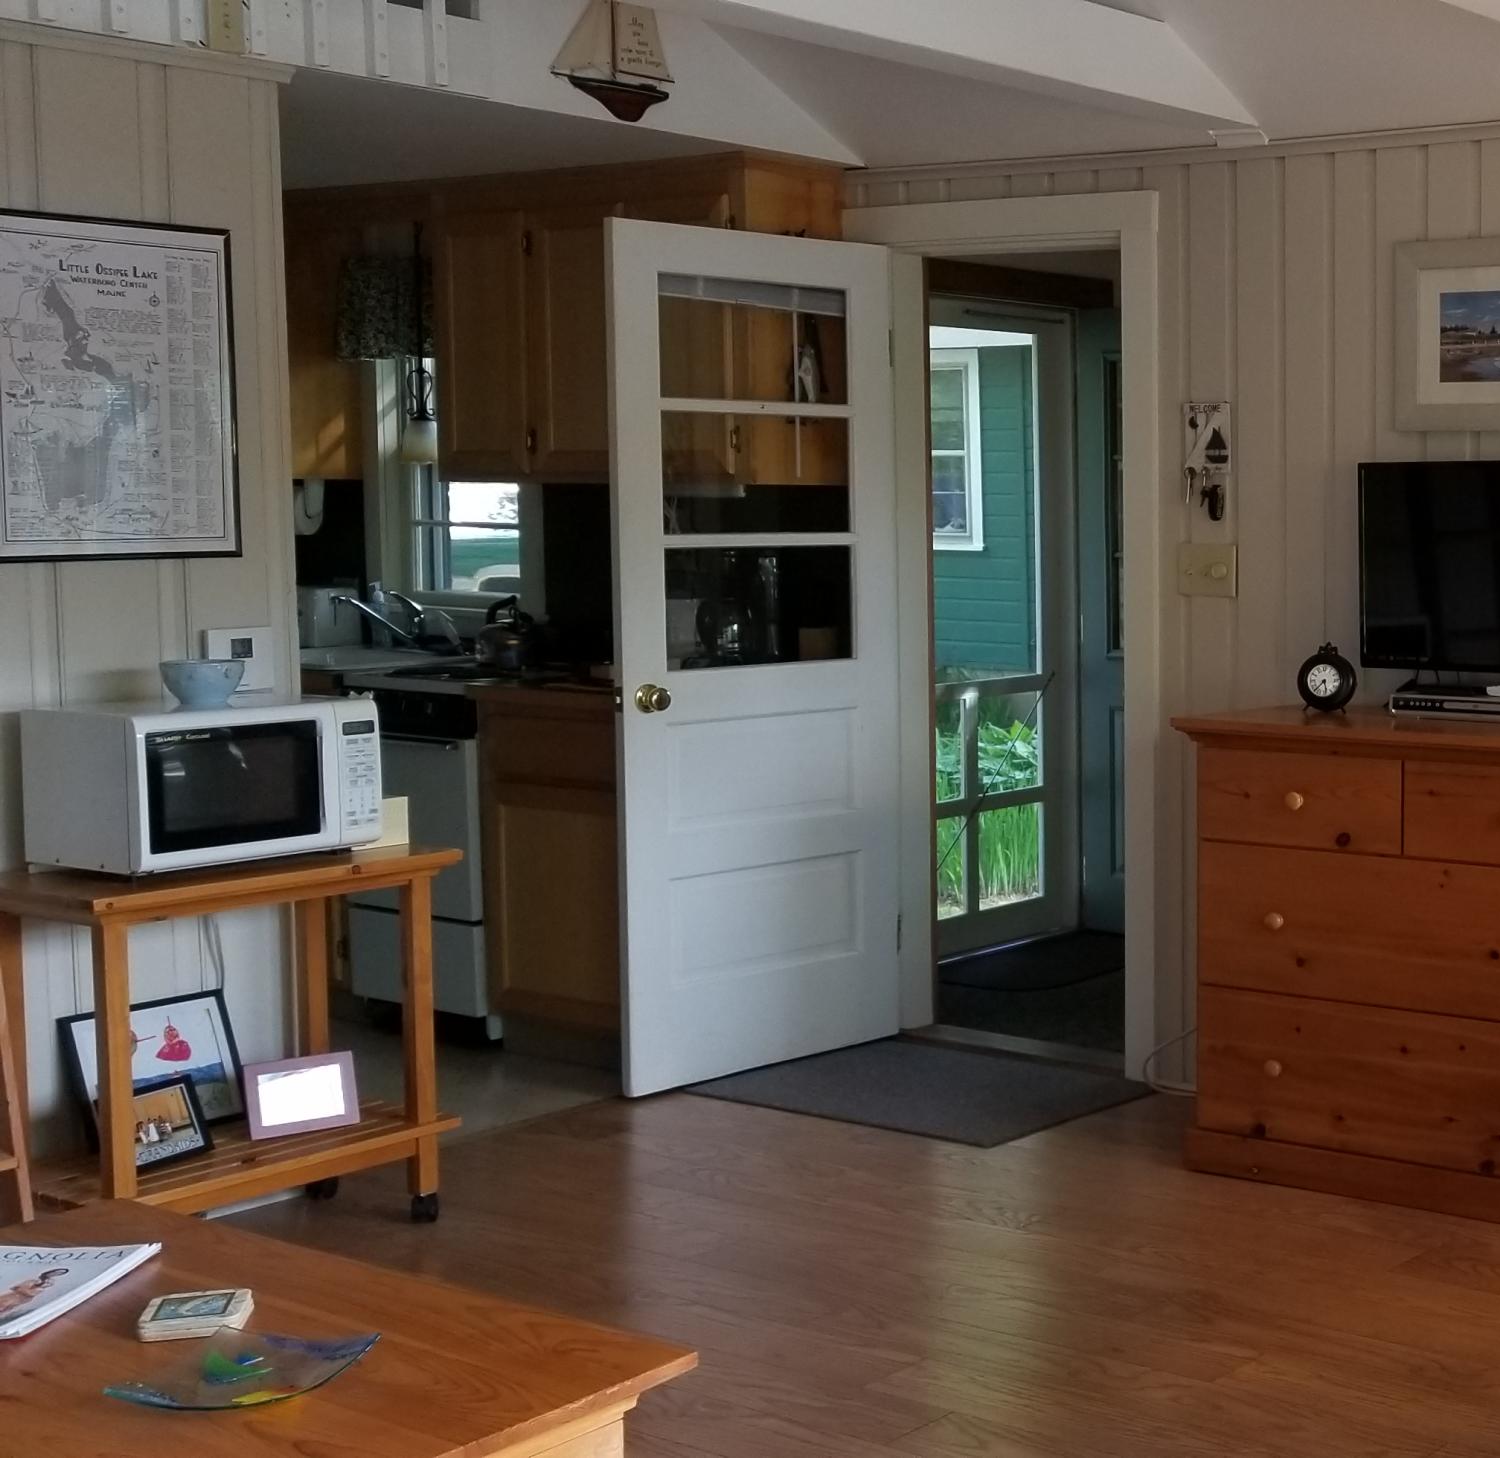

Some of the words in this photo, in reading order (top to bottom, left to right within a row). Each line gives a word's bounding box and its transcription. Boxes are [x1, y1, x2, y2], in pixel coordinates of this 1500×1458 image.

[58, 259, 89, 273] LITTLE
[132, 266, 158, 279] LAKE
[97, 289, 126, 297] MAINE
[1189, 403, 1221, 413] WELCOME
